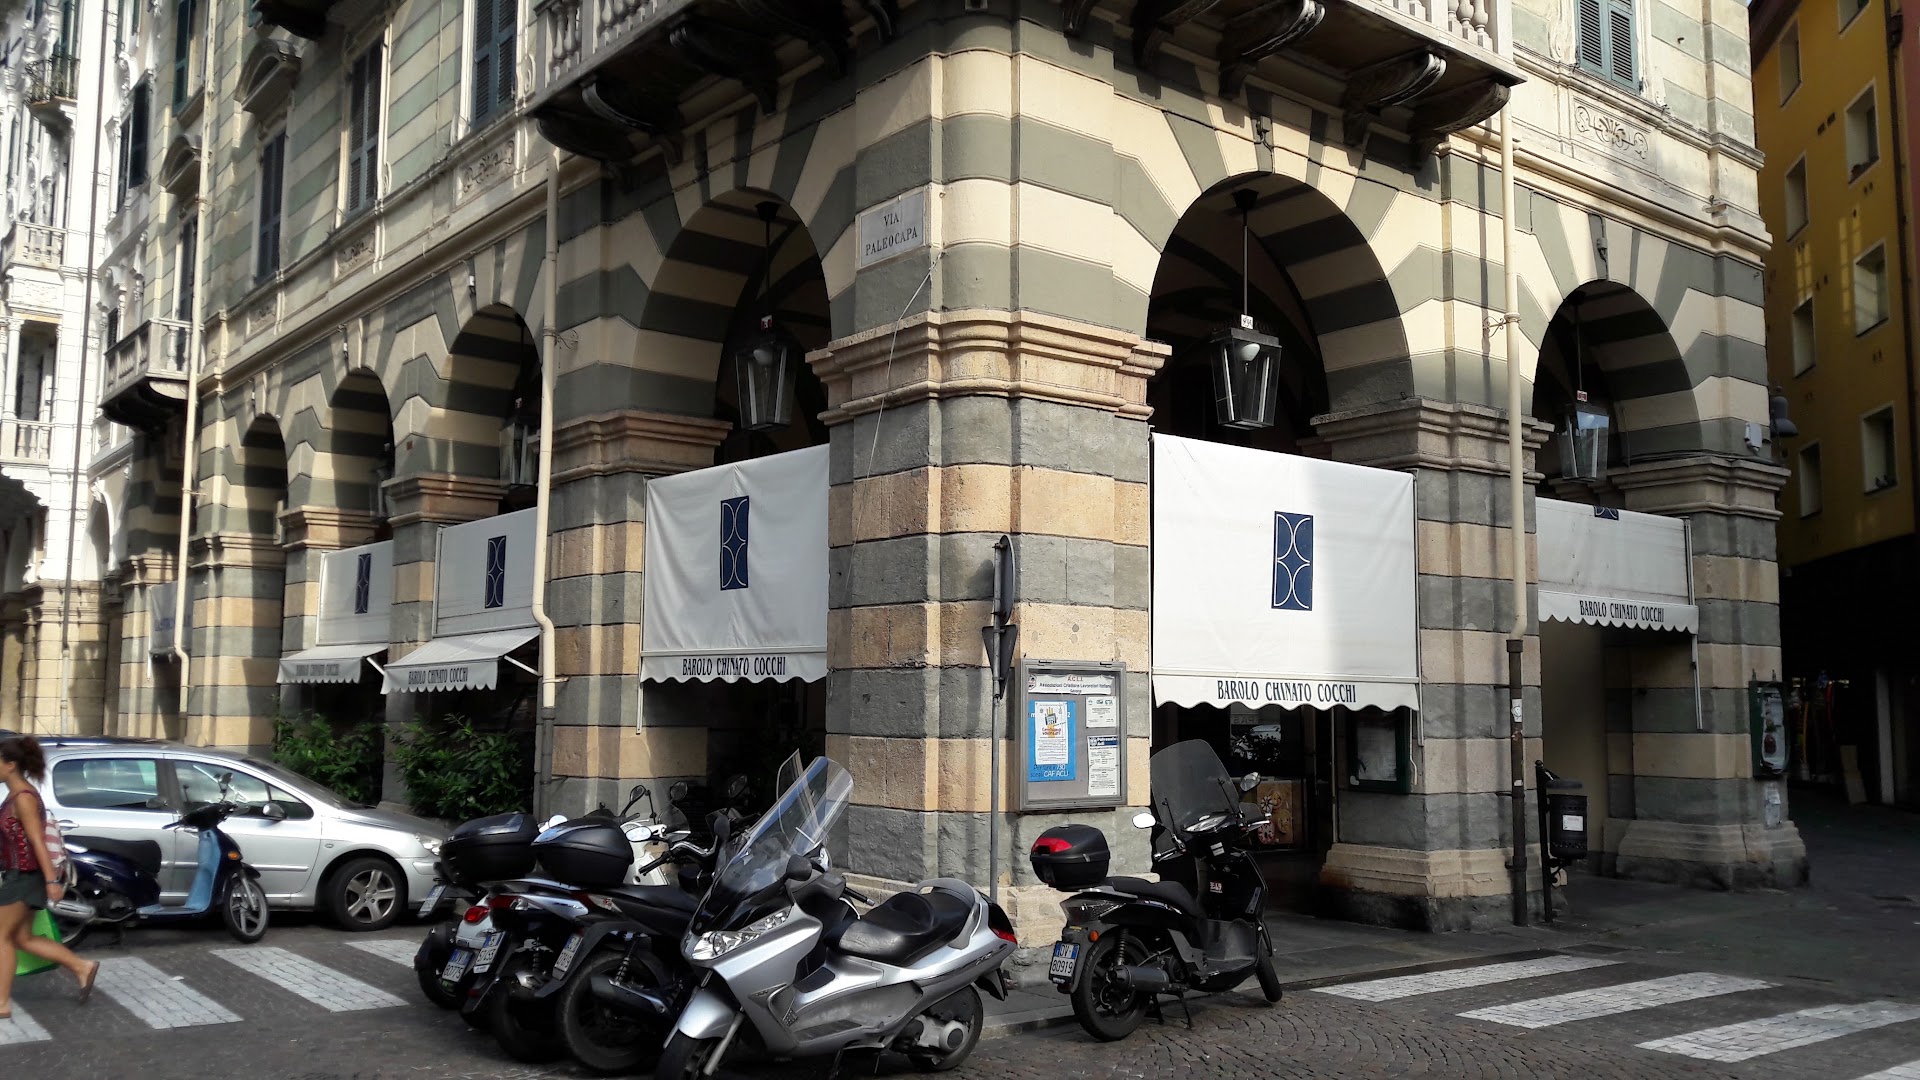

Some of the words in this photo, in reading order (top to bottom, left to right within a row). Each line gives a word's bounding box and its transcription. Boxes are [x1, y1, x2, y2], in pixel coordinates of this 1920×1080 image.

[883, 212, 899, 227] VIA
[865, 226, 918, 256] PALEOCAPA
[1579, 600, 1607, 618] BAROLO
[1610, 603, 1638, 620] CHINATO
[1641, 606, 1664, 623] COCCHI
[408, 670, 426, 685] BAROLO
[427, 668, 448, 684] CHINATO
[449, 667, 469, 683] COCCHI
[682, 658, 712, 676] BAROLO
[716, 657, 749, 676] CHINATO
[754, 656, 786, 675] COCCHI
[1217, 680, 1259, 700] BAROLO
[1265, 681, 1312, 702] CHINATO
[1317, 683, 1356, 703] COCCHI
